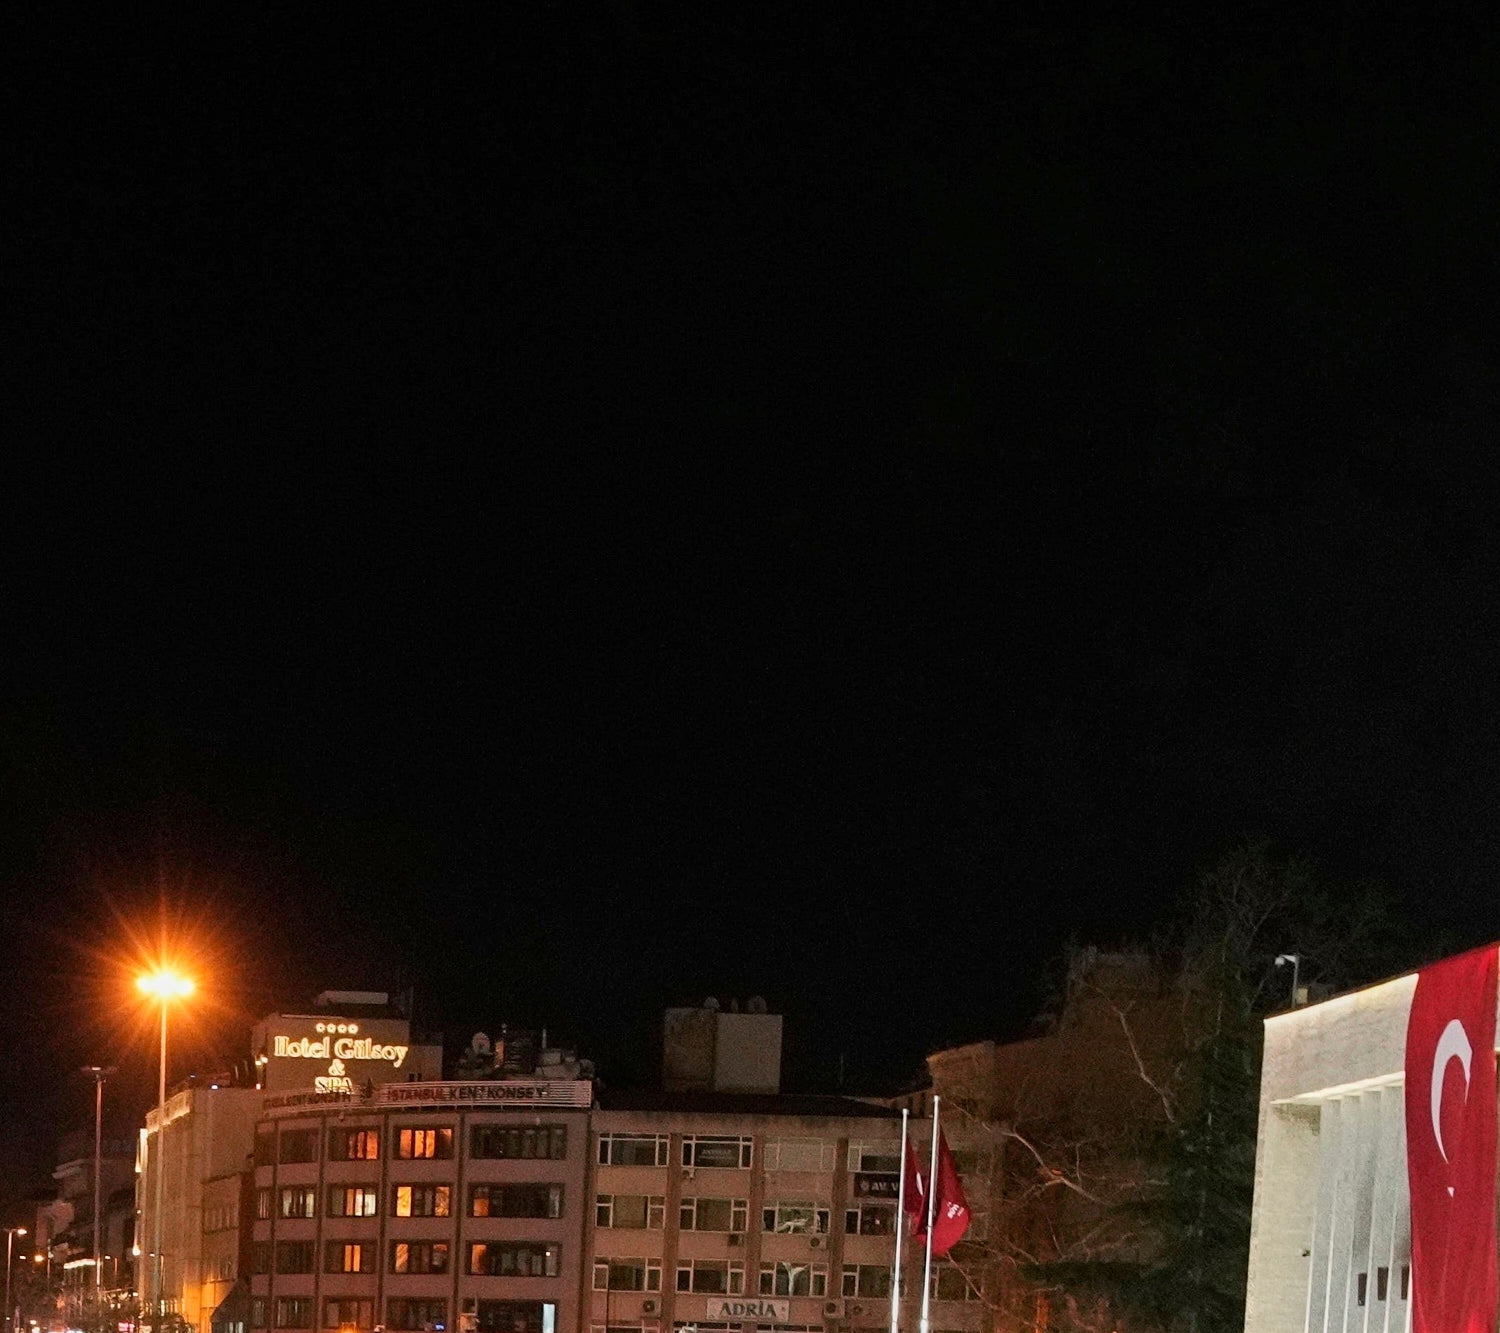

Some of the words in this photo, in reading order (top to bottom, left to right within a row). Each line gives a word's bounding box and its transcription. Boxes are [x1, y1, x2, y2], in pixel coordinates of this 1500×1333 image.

[274, 1036, 330, 1059] Hotel
[334, 1037, 408, 1067] Gülsoy
[328, 1058, 346, 1076] &
